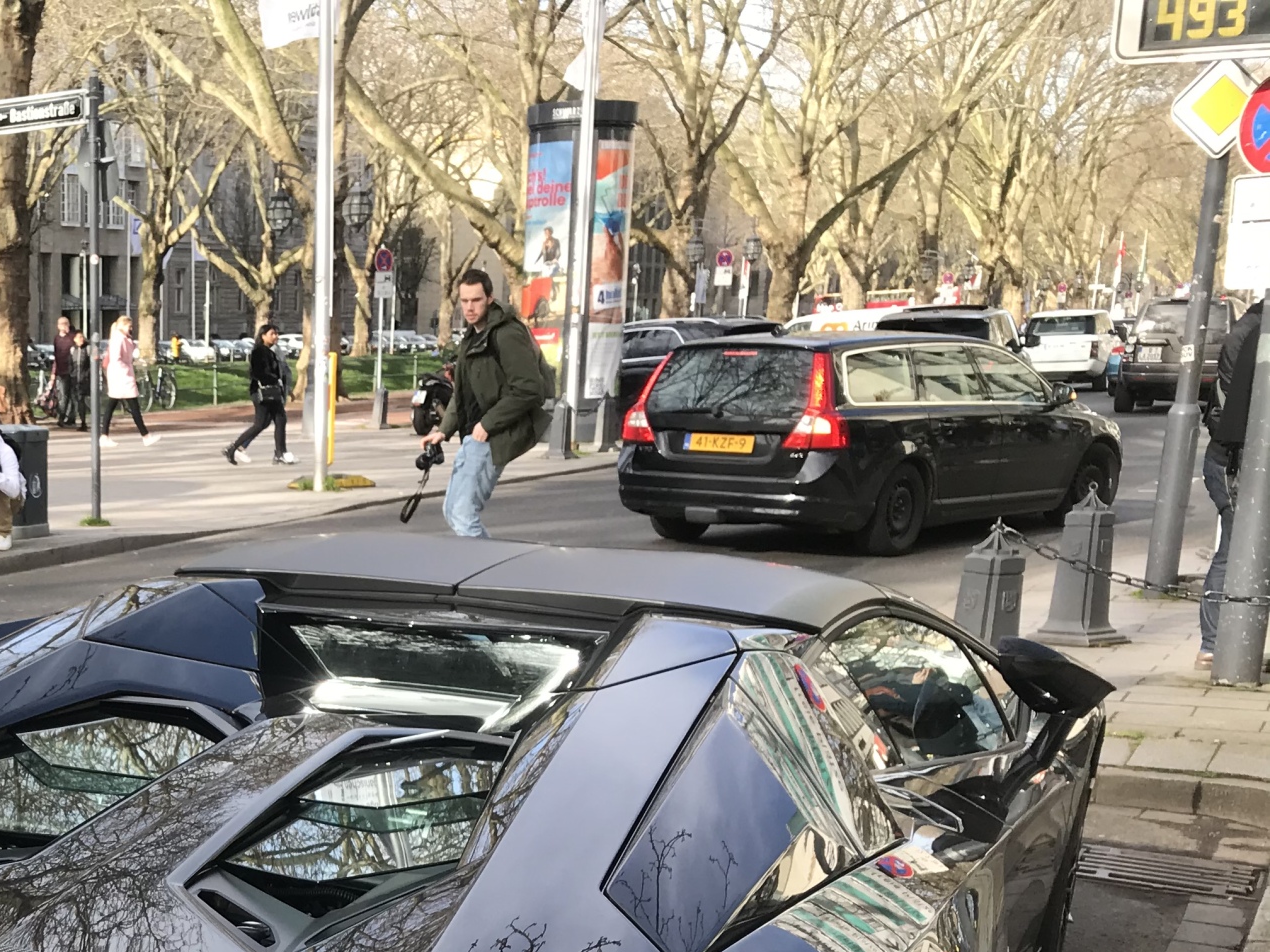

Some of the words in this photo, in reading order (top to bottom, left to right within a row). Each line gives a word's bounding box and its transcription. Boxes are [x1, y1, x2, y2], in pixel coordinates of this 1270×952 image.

[1157, 0, 1247, 41] 493
[9, 101, 76, 124] Bastionstraße
[696, 438, 747, 449] 41-KZF-9
